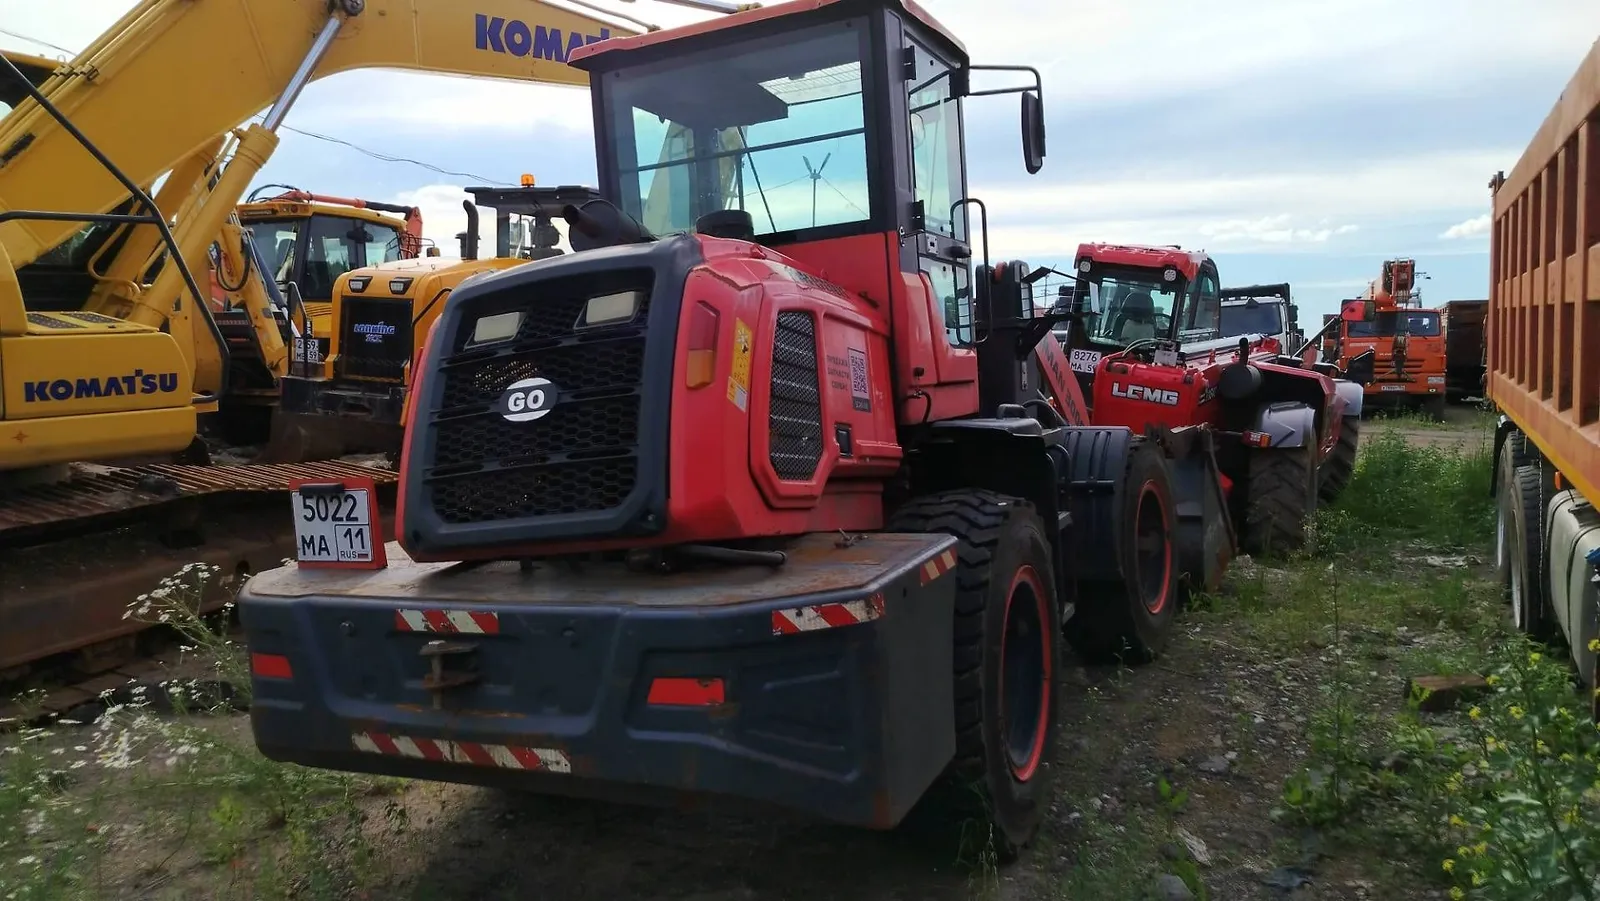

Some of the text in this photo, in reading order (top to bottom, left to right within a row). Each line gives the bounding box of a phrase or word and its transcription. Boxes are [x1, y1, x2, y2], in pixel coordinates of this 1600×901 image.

[1074, 351, 1097, 362] 8276
[24, 369, 178, 402] KOMATSU
[507, 389, 545, 412] GO
[302, 493, 359, 522] 5022
[301, 527, 365, 556] MA 11
[340, 550, 357, 559] RUS
